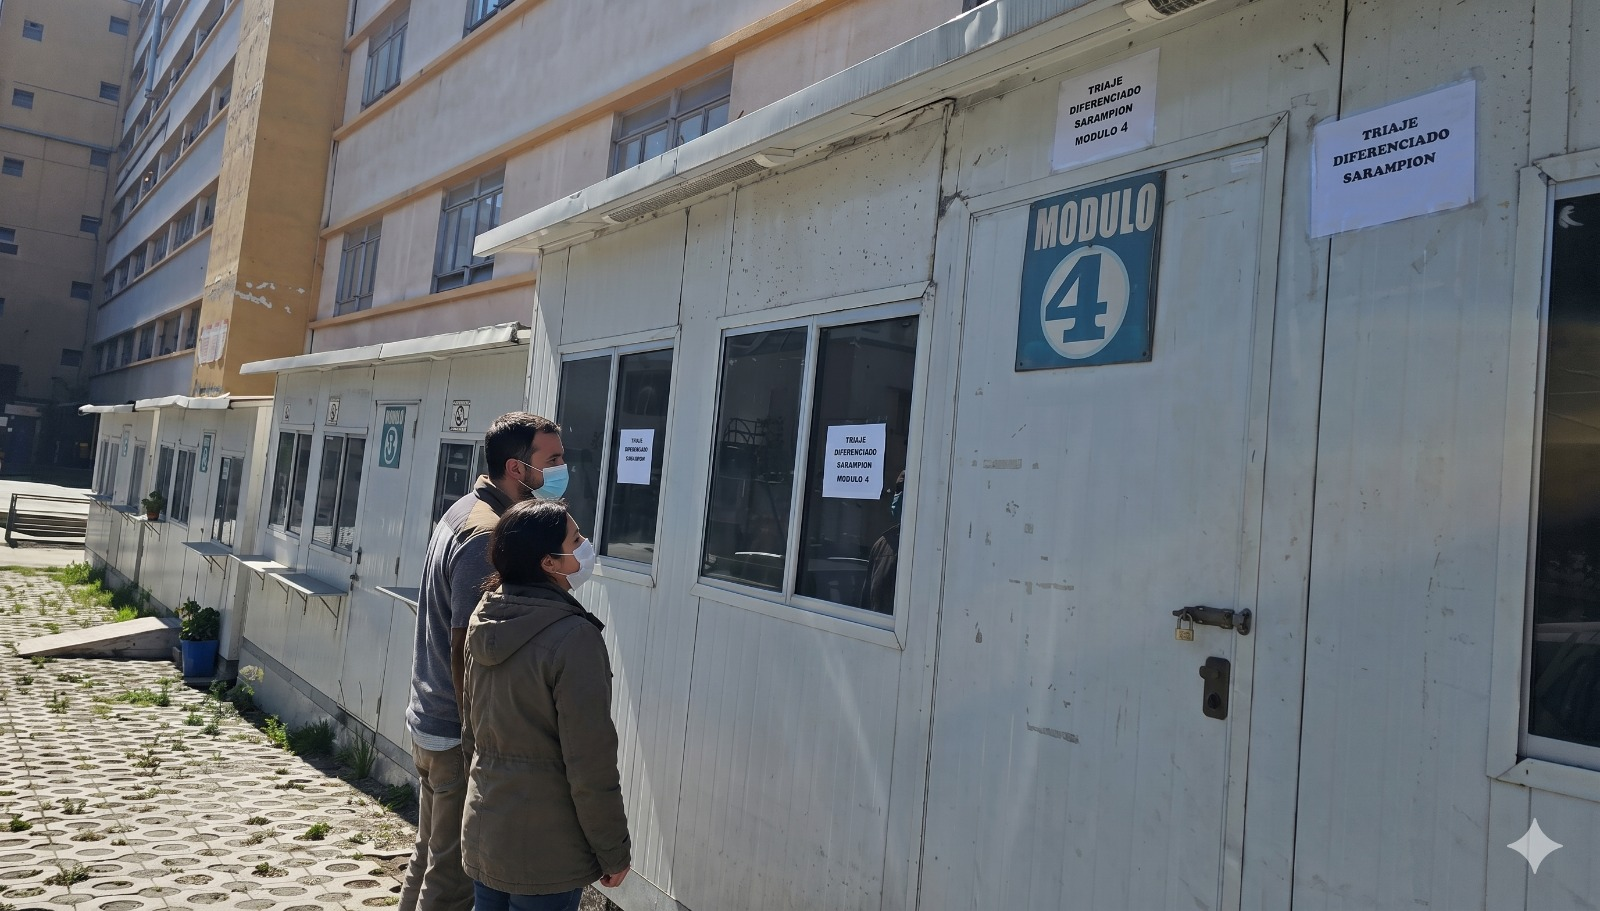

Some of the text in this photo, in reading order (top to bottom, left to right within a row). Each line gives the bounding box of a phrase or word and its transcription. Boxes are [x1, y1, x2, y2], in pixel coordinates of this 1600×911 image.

[1088, 76, 1123, 95] TRIAJE
[1069, 85, 1141, 115] DIFERENCIADO
[1074, 103, 1133, 128] SARAMPION
[1075, 121, 1128, 146] MODULO 4
[1362, 117, 1419, 141] TRIAJE
[1333, 128, 1450, 167] DIFERENCIADO
[1343, 152, 1436, 184] SARAMPION
[1034, 182, 1157, 251] MODULO
[1044, 253, 1108, 344] 4
[834, 448, 877, 456] DIFERENCIADO
[836, 461, 872, 469] SARAMPION
[836, 475, 863, 483] MODULO
